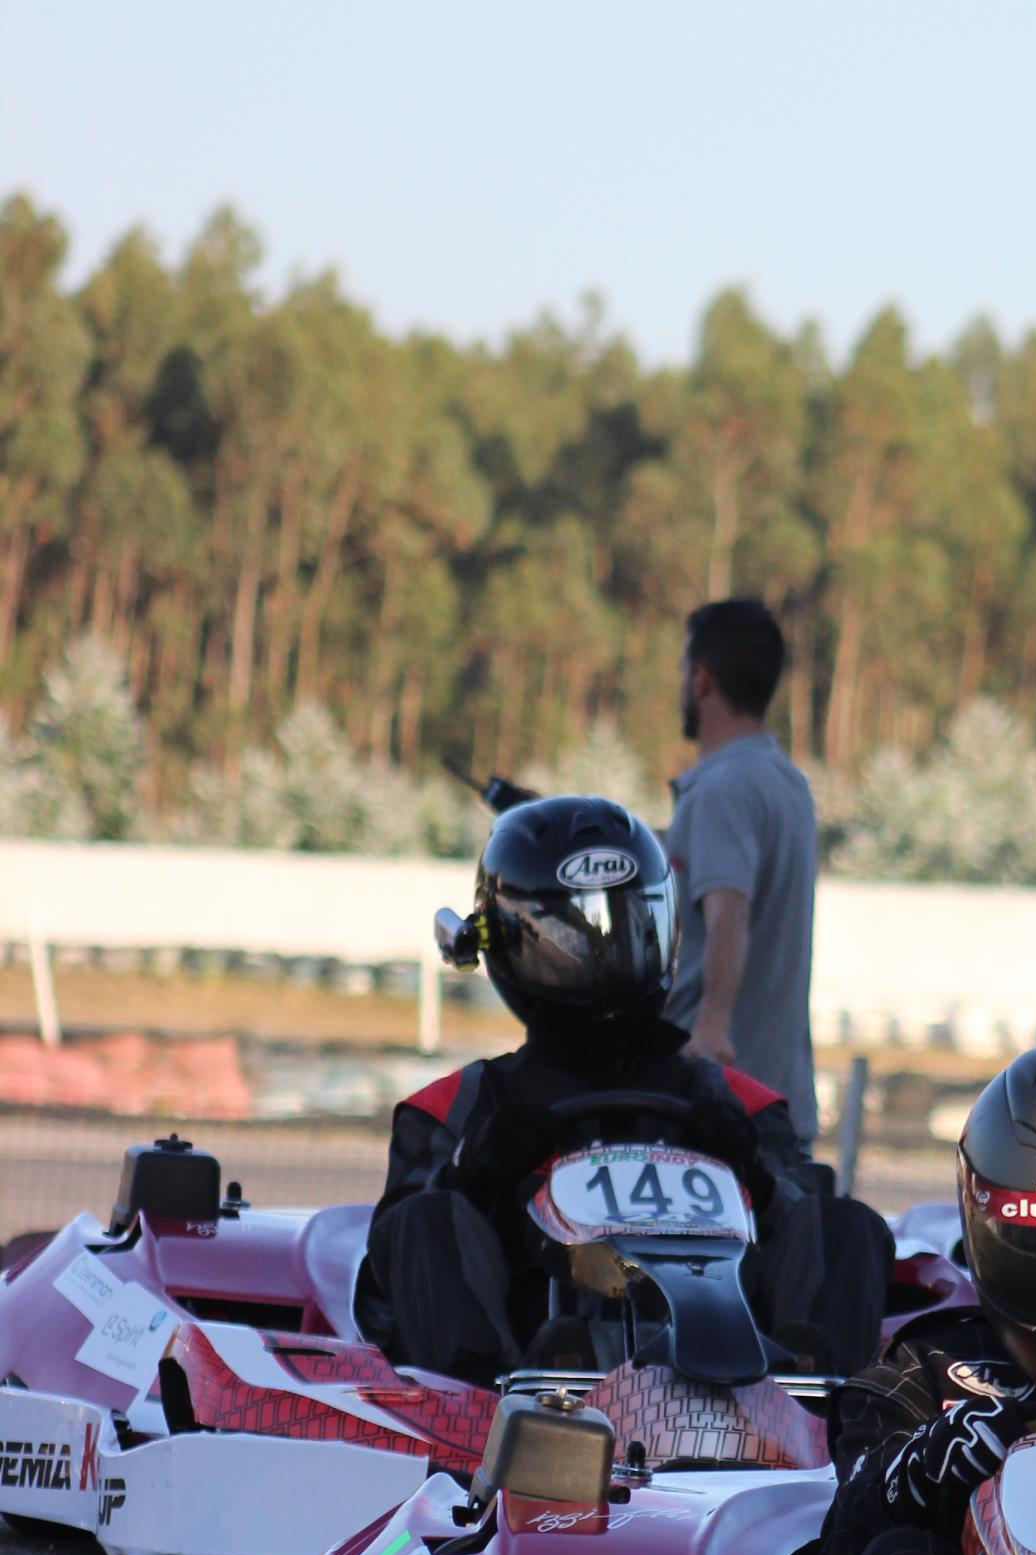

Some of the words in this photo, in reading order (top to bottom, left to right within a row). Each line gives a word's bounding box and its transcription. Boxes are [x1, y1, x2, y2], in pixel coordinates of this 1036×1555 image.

[563, 853, 627, 880] Arai
[586, 1163, 724, 1220] 149
[0, 1441, 71, 1491] EMIA
